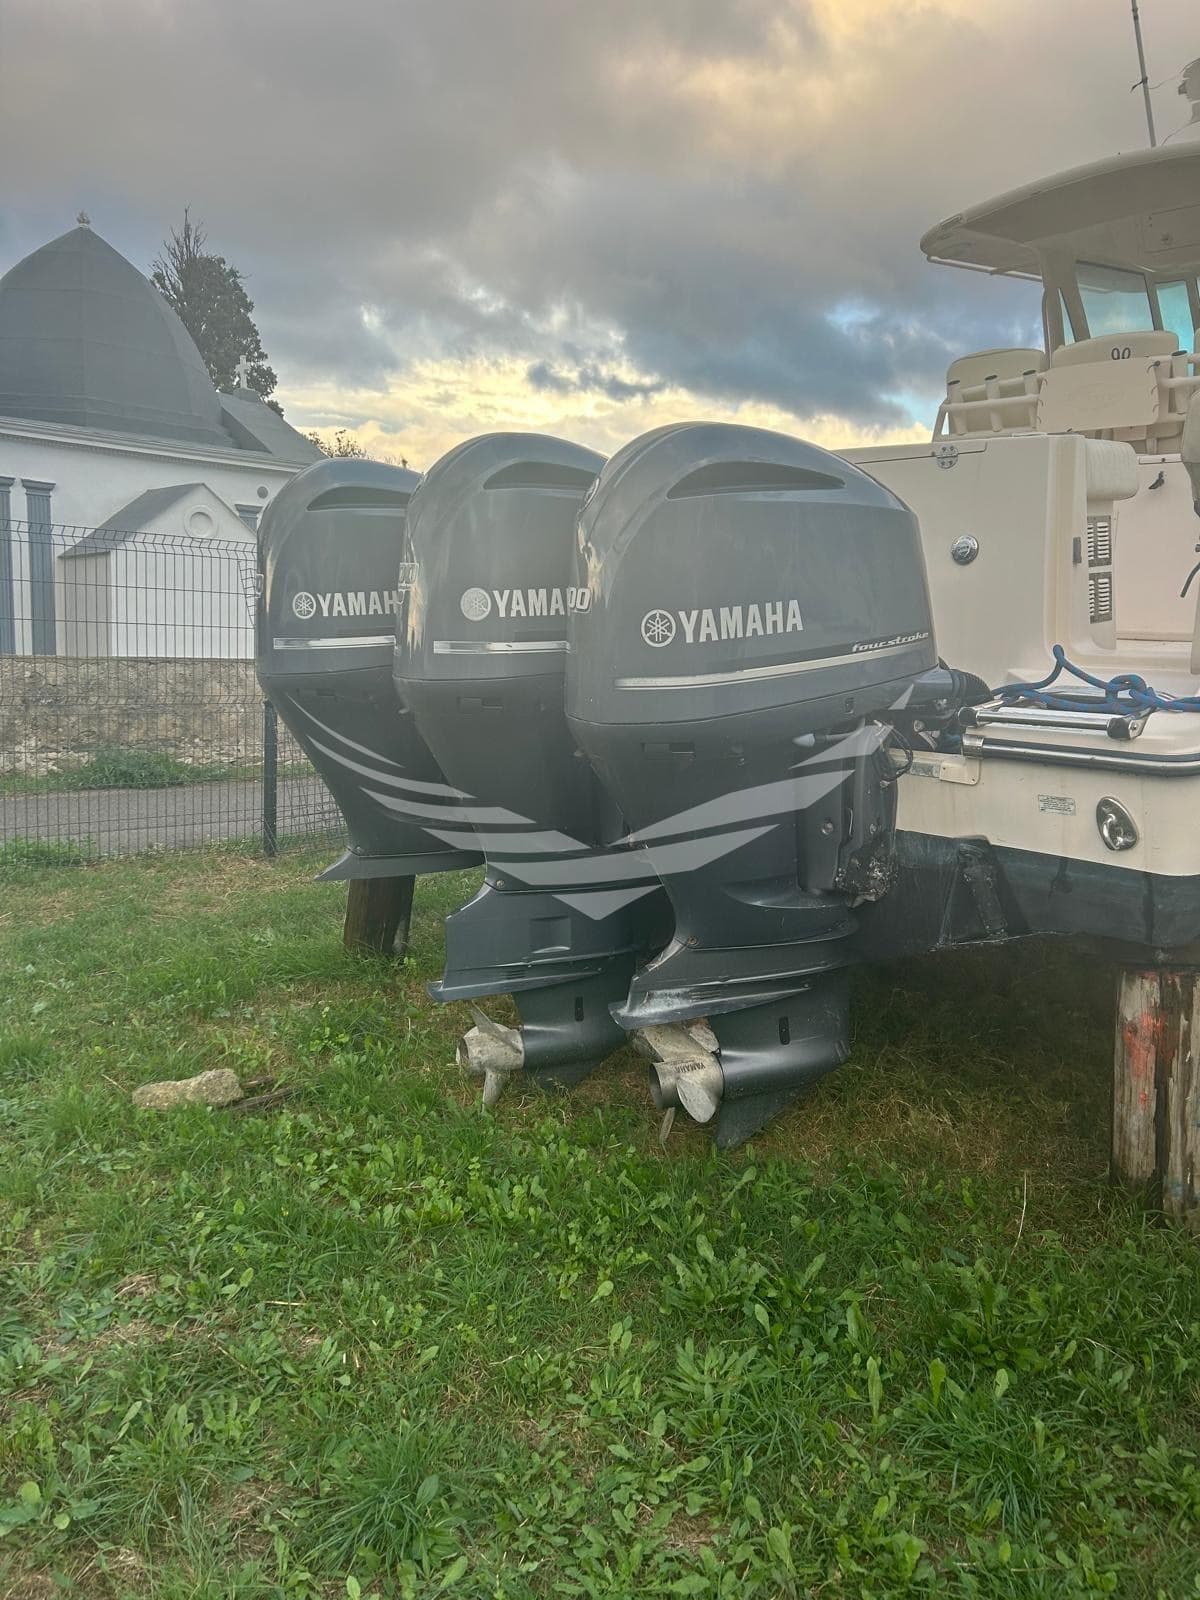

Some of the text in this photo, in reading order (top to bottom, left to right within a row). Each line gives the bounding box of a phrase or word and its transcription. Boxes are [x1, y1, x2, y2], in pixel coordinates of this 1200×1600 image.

[316, 590, 399, 617] YAMAH
[492, 587, 571, 618] YAMA
[679, 599, 804, 643] YAMAHA
